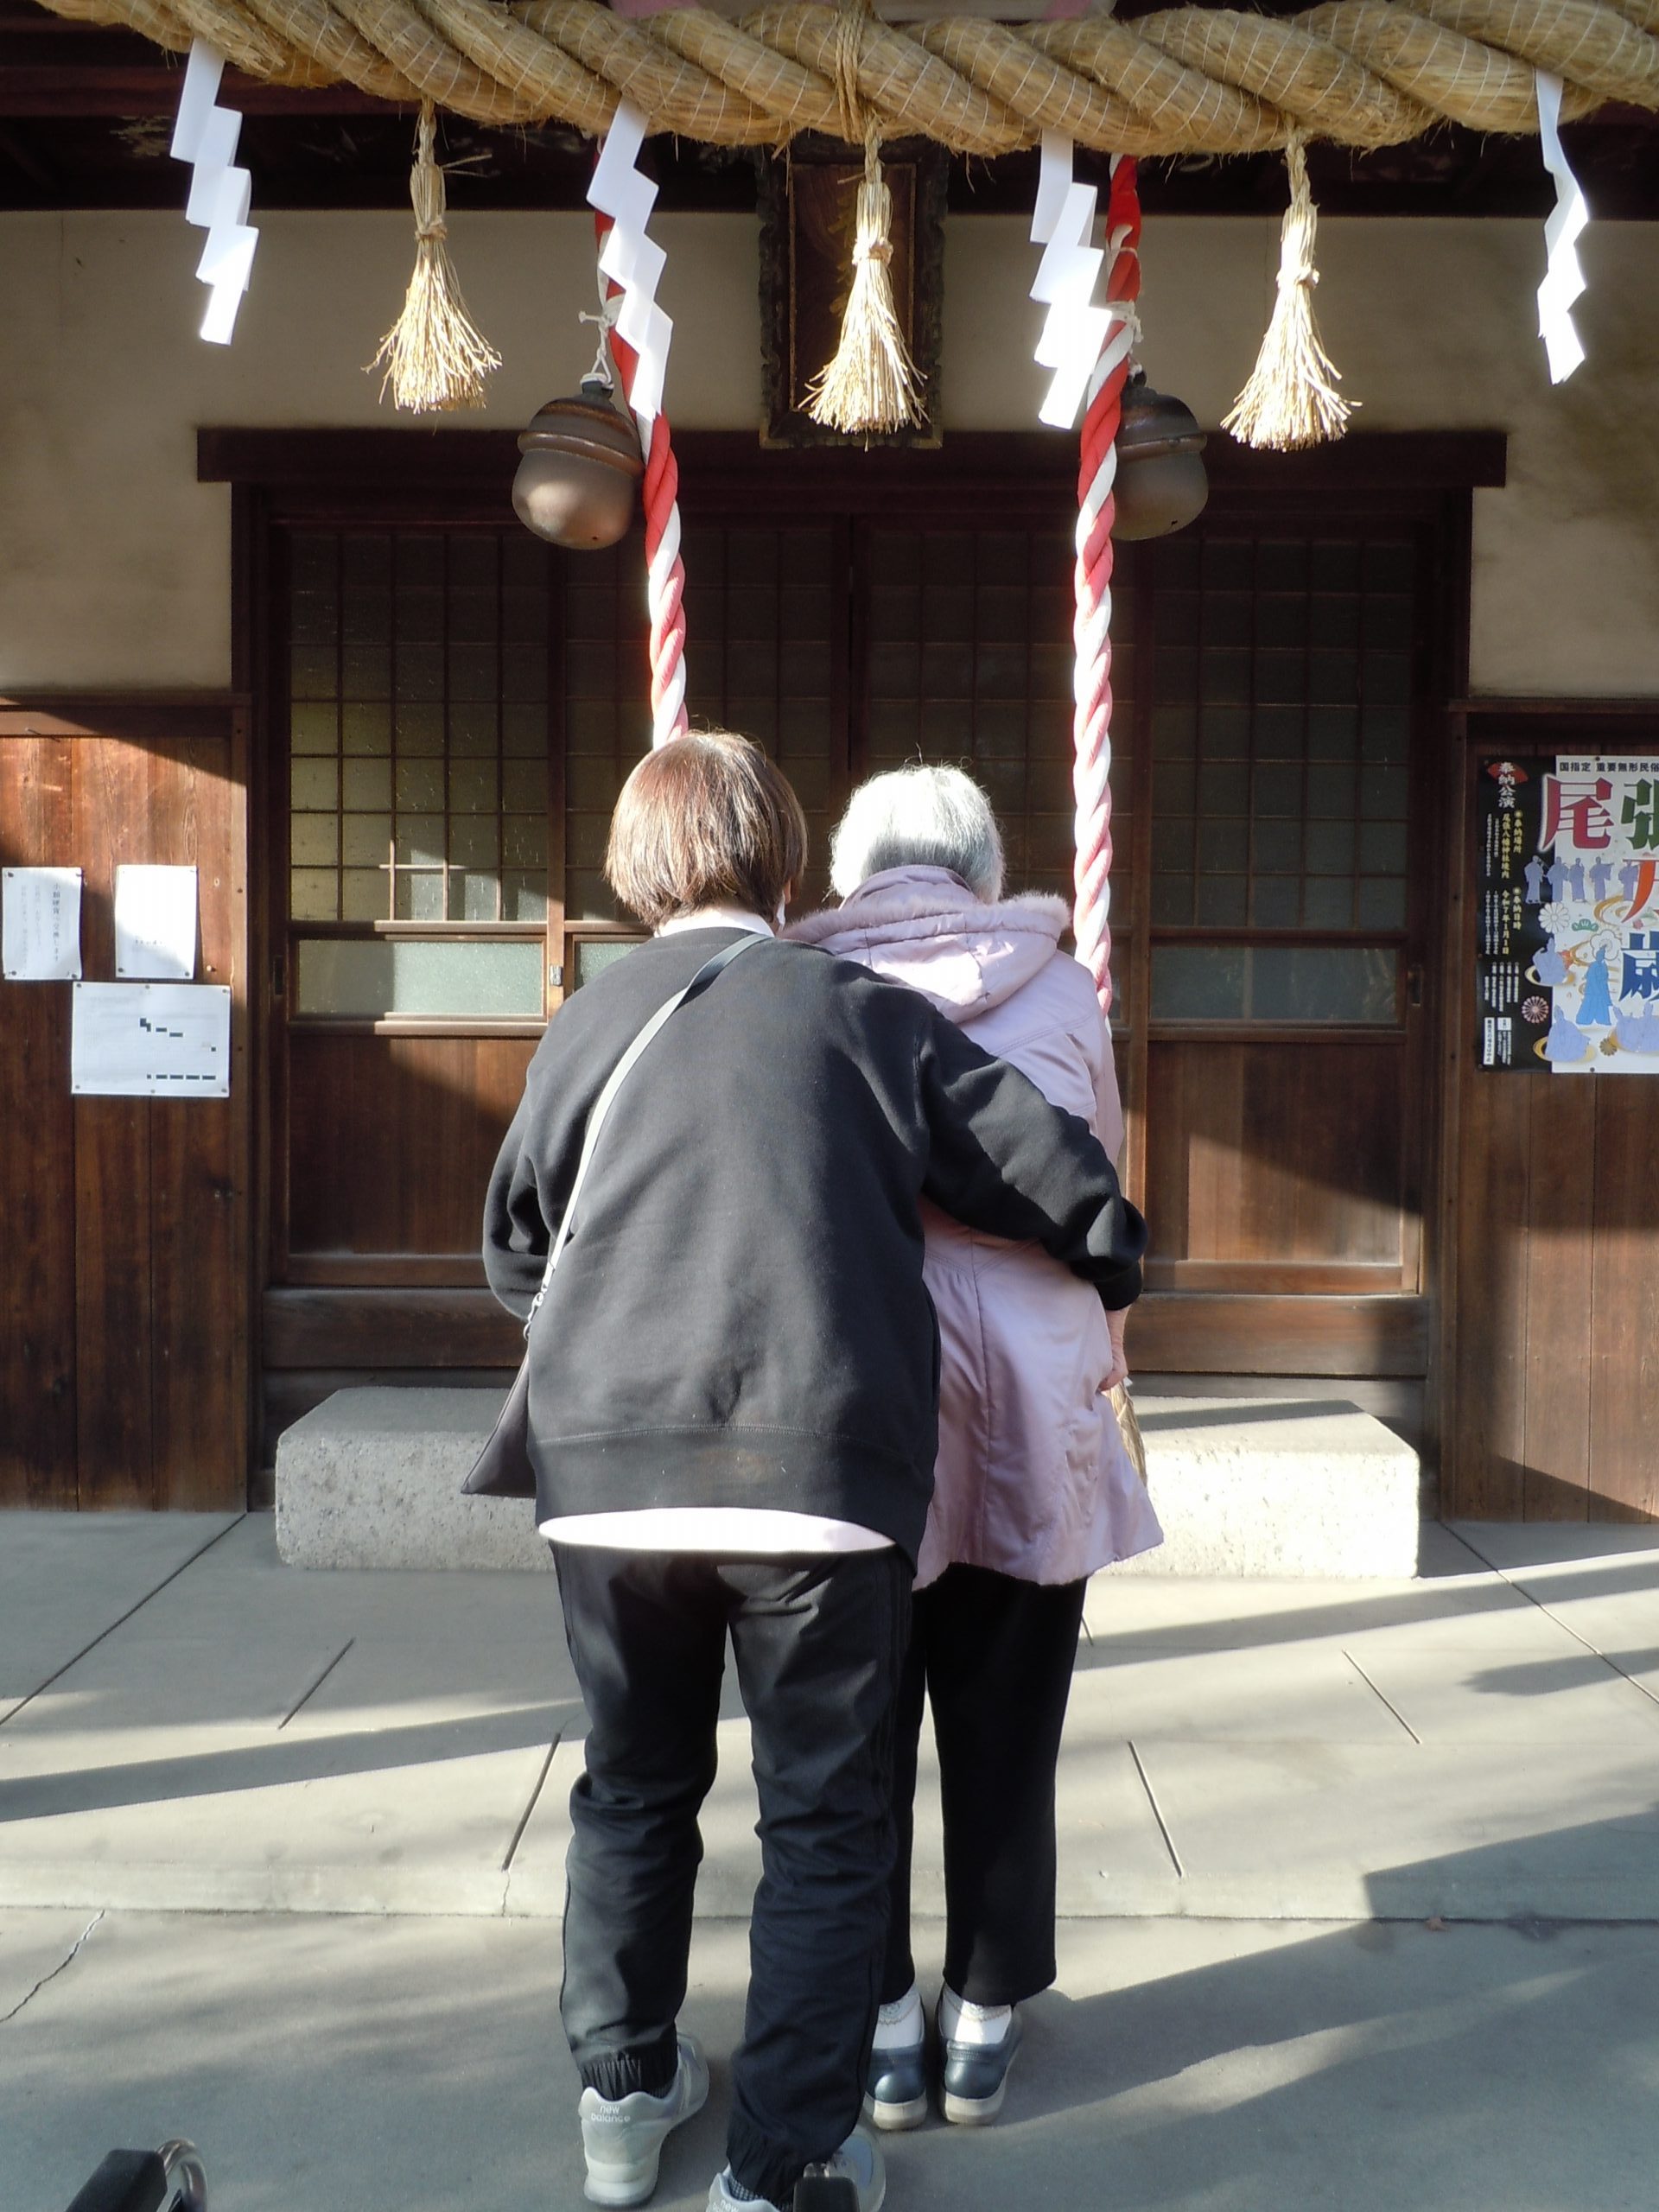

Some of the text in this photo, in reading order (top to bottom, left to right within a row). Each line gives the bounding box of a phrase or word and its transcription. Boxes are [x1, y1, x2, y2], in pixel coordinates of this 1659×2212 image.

[1560, 762, 1659, 772] 国指定 重要無形民俗
[1498, 762, 1516, 809] 奉納公演
[600, 2105, 620, 2114] new
[591, 2113, 631, 2122] balance
